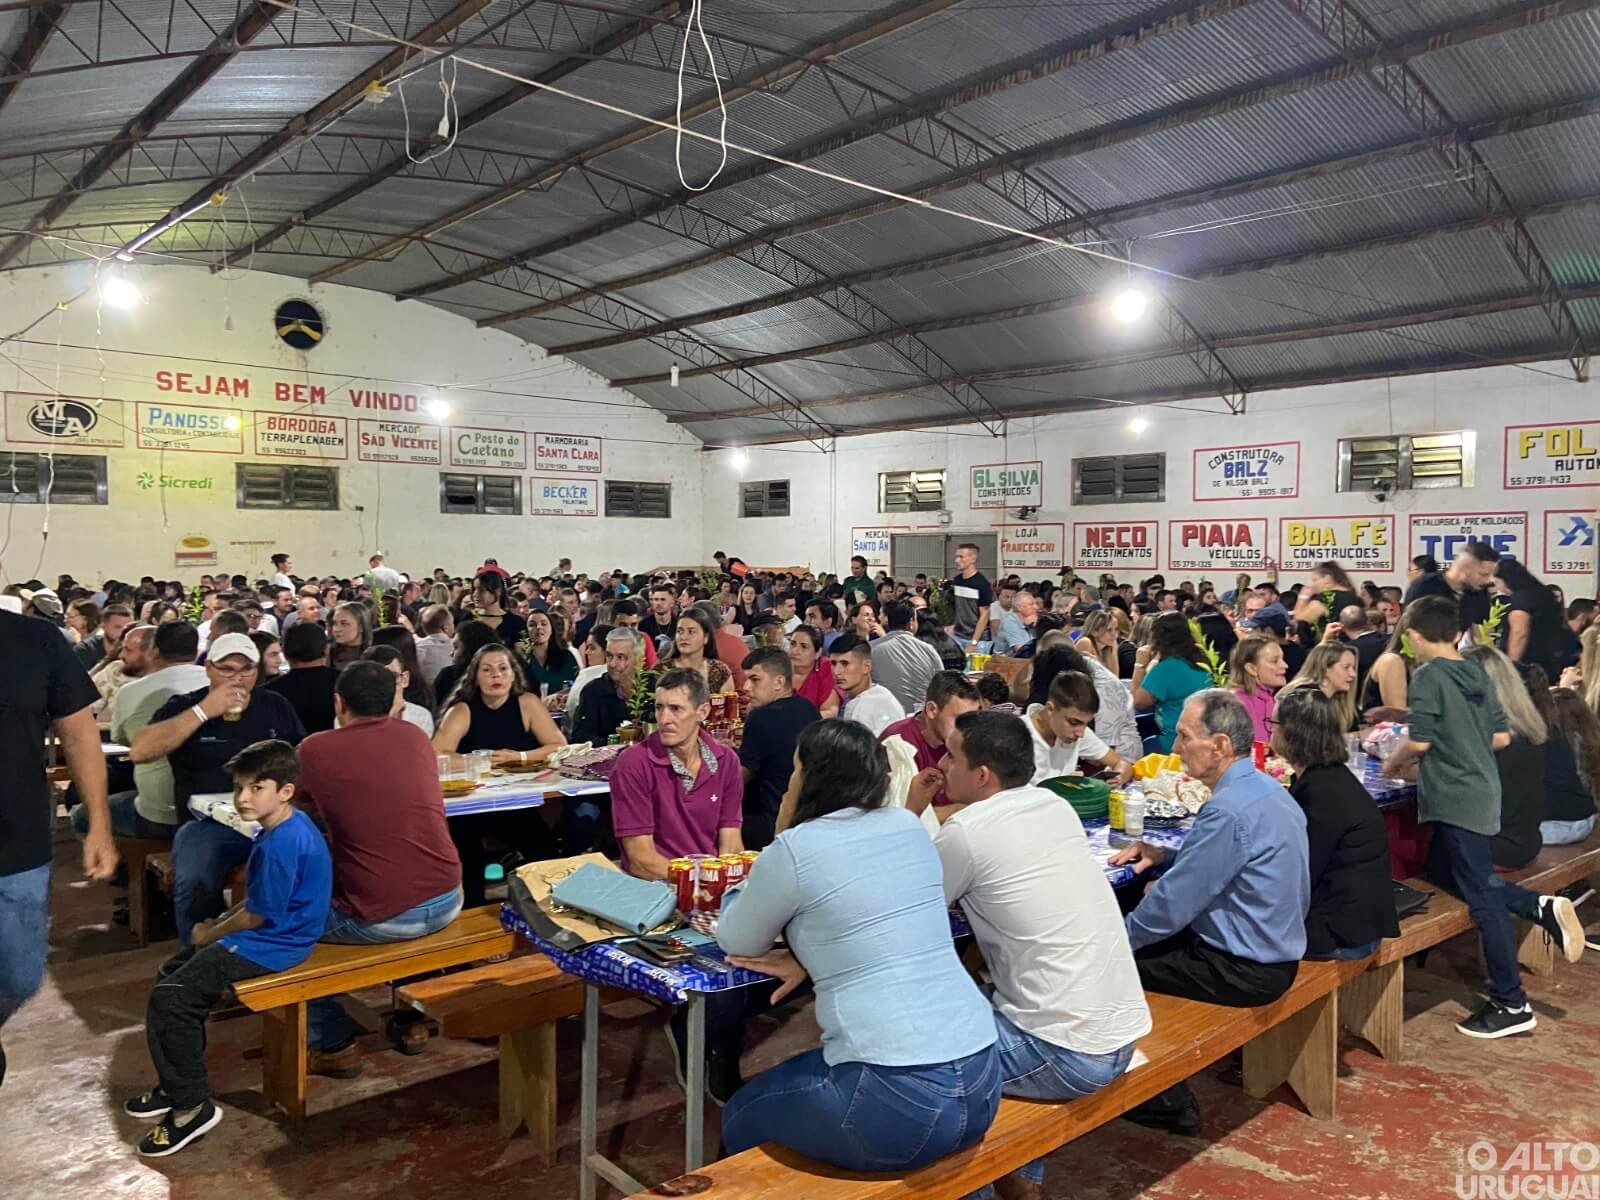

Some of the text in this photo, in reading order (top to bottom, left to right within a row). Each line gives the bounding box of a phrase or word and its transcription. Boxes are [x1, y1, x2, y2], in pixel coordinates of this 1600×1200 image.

[156, 371, 249, 398] SEJAM
[275, 382, 326, 404] BEM
[148, 407, 236, 430] PANOSS
[267, 416, 336, 433] BORDOGA
[261, 432, 344, 446] TERRAPLENAGEM
[391, 434, 438, 450] VICENTE
[458, 434, 514, 457] Caetano
[475, 433, 504, 444] Posto
[545, 436, 588, 446] MARMORARIA
[538, 446, 599, 460] SANTA CLARA
[1208, 449, 1285, 470] CONSTRUTORA
[1224, 460, 1268, 478] BALZ
[158, 475, 213, 489] Sicredi
[973, 469, 1039, 488] GL SILVA
[543, 486, 587, 498] BECKER
[1016, 528, 1038, 538] LOJA
[1086, 526, 1147, 548] NECO
[1182, 524, 1253, 547] PIAIA
[1288, 522, 1337, 546] BOA
[1081, 548, 1152, 558] REVESTIMENTOS
